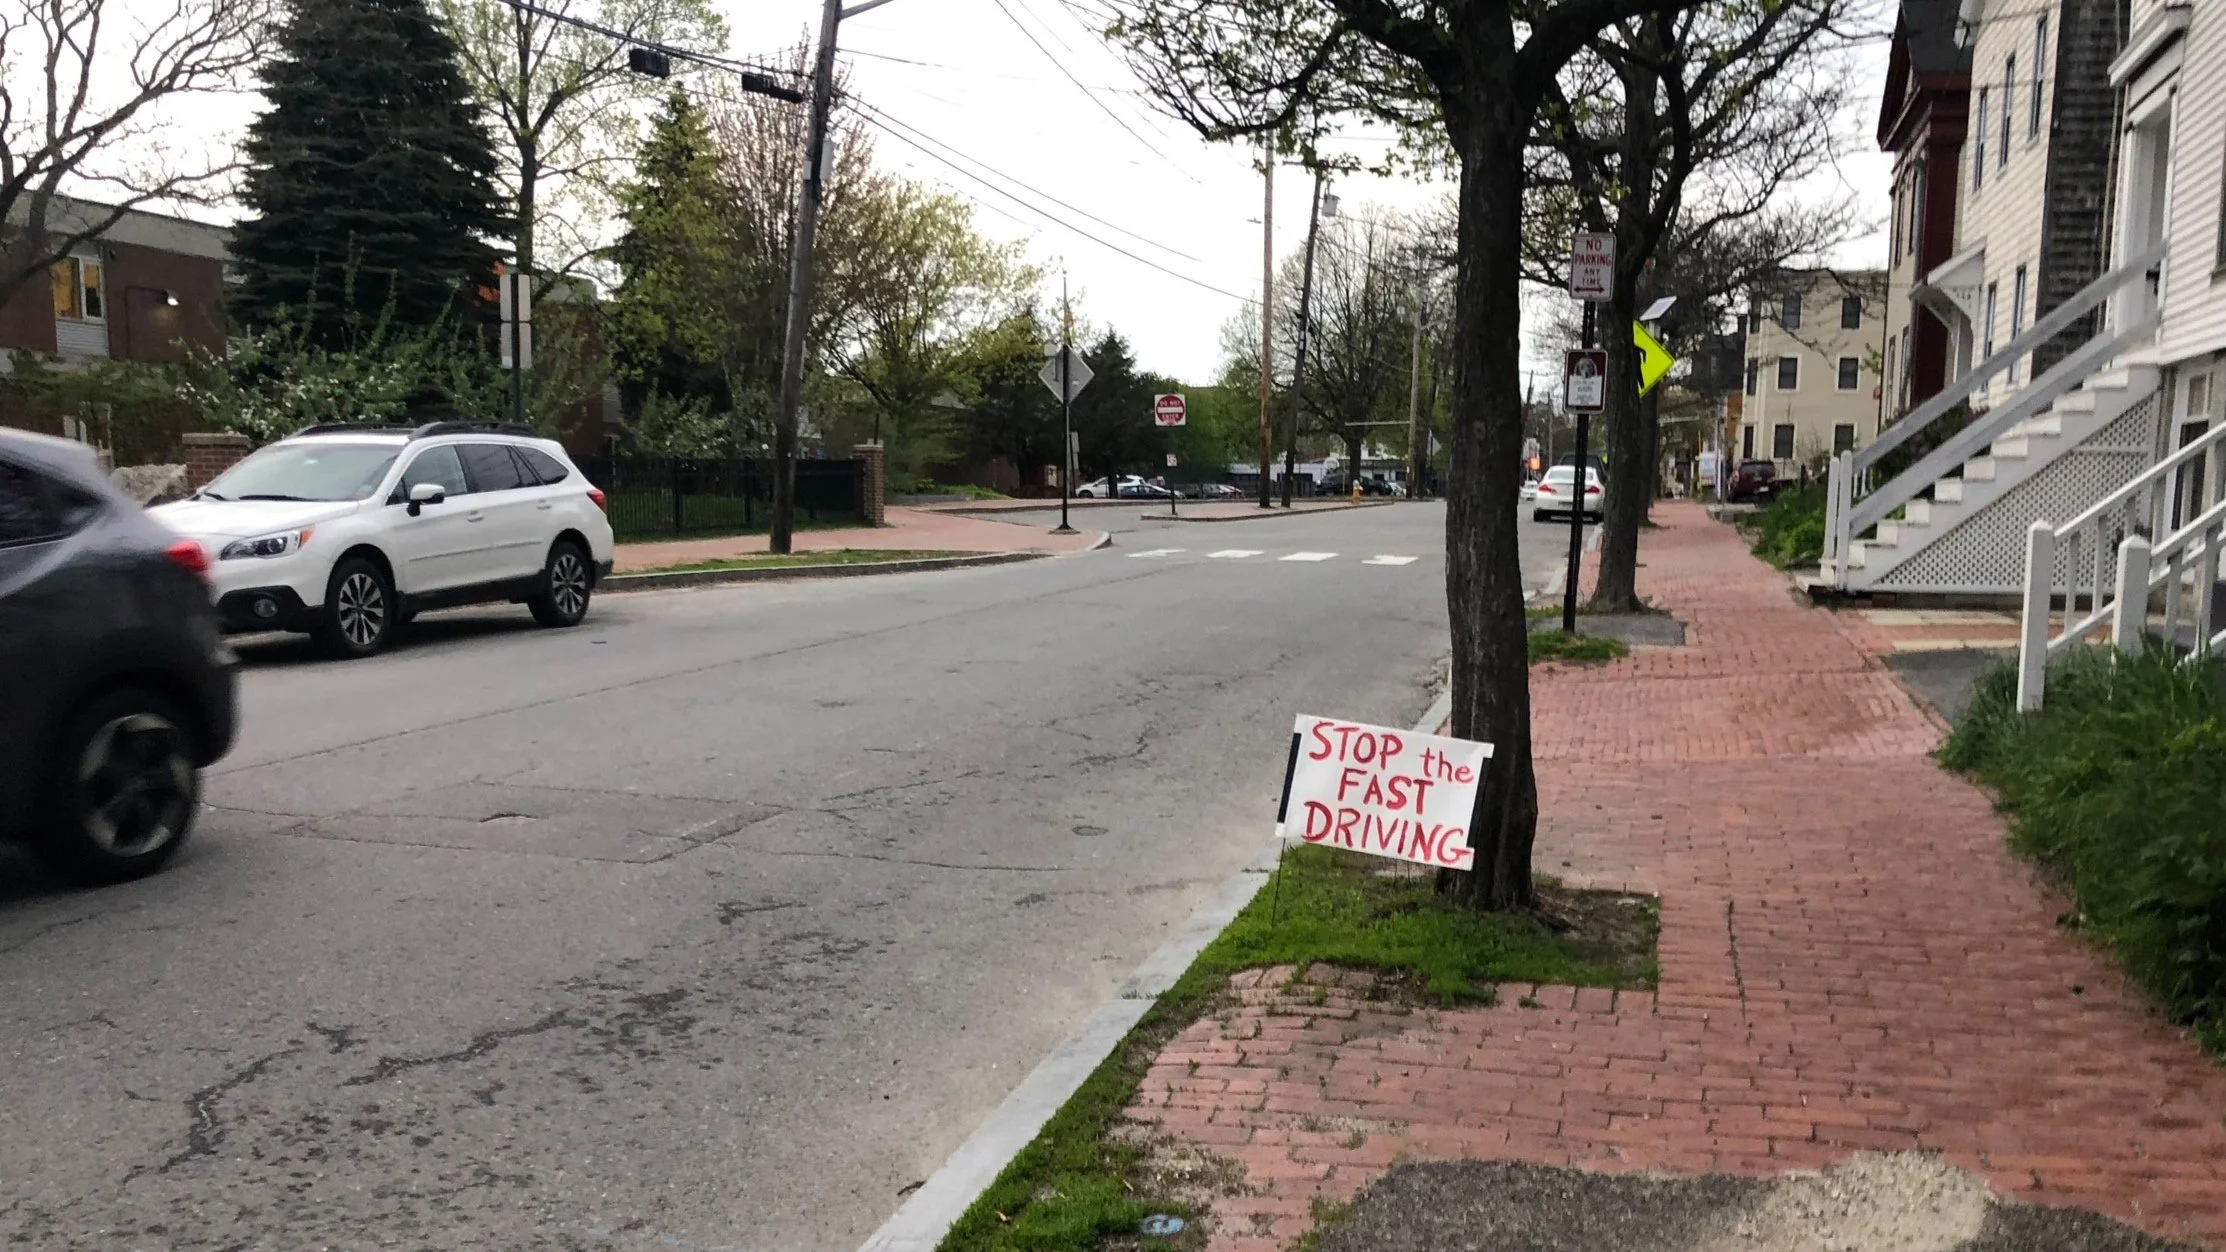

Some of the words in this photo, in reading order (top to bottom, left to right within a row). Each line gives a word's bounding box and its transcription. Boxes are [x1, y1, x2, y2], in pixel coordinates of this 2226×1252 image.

[1586, 239, 1602, 251] NO
[1575, 254, 1612, 267] PARKING
[1585, 267, 1600, 275] ANY
[1309, 721, 1403, 770] STOP
[1419, 747, 1474, 783] the
[1337, 767, 1434, 815] FAST
[1301, 800, 1472, 865] DRIVING
